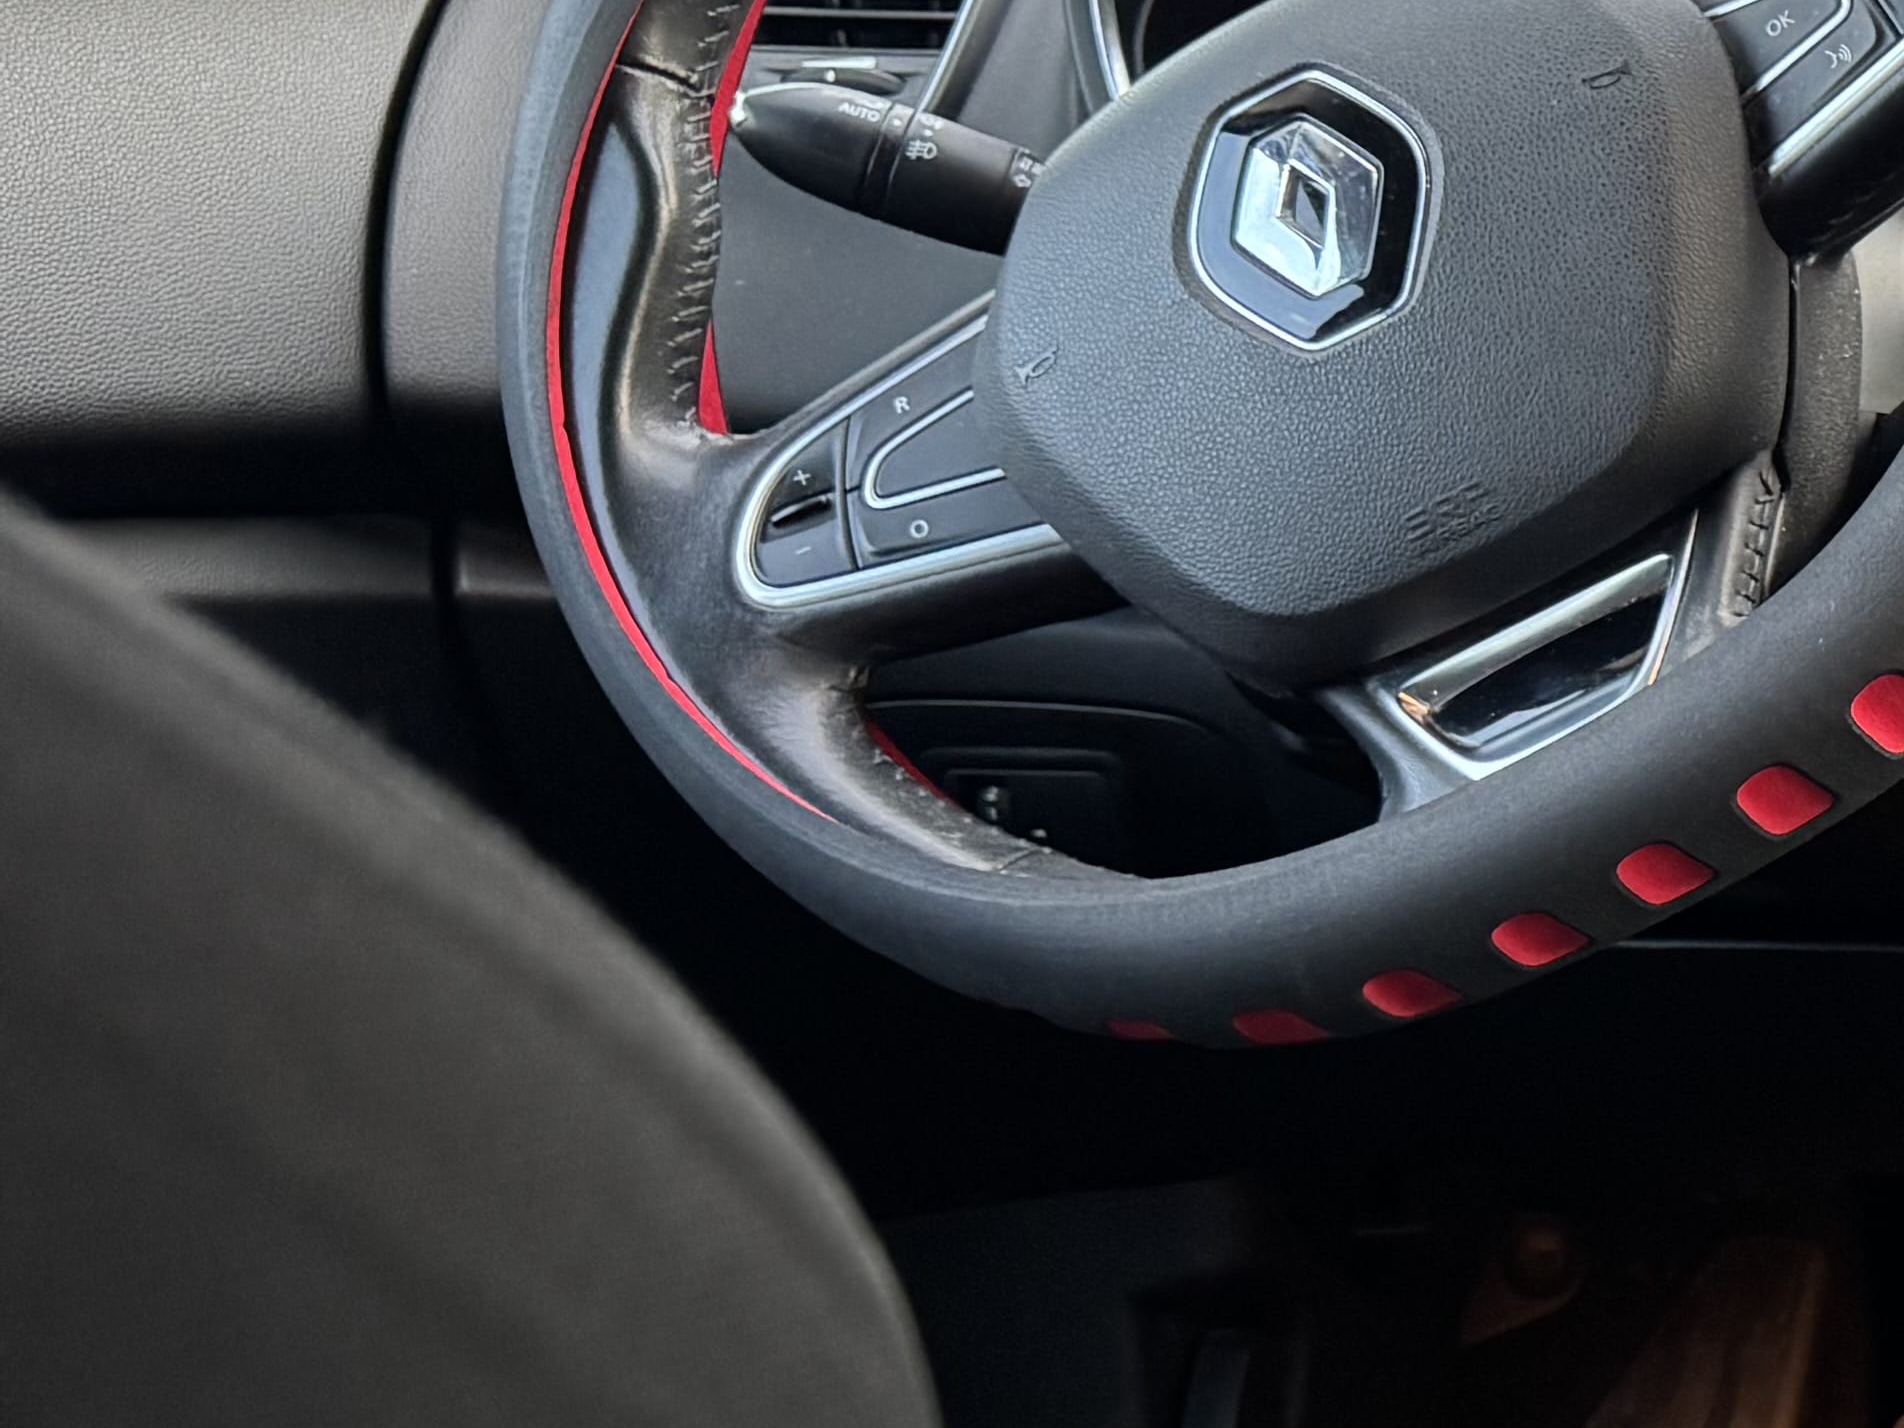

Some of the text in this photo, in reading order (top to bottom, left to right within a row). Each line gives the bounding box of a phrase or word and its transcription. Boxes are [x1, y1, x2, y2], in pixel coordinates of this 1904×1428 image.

[1766, 10, 1795, 37] OK
[838, 101, 882, 122] AUTO
[892, 395, 910, 414] R
